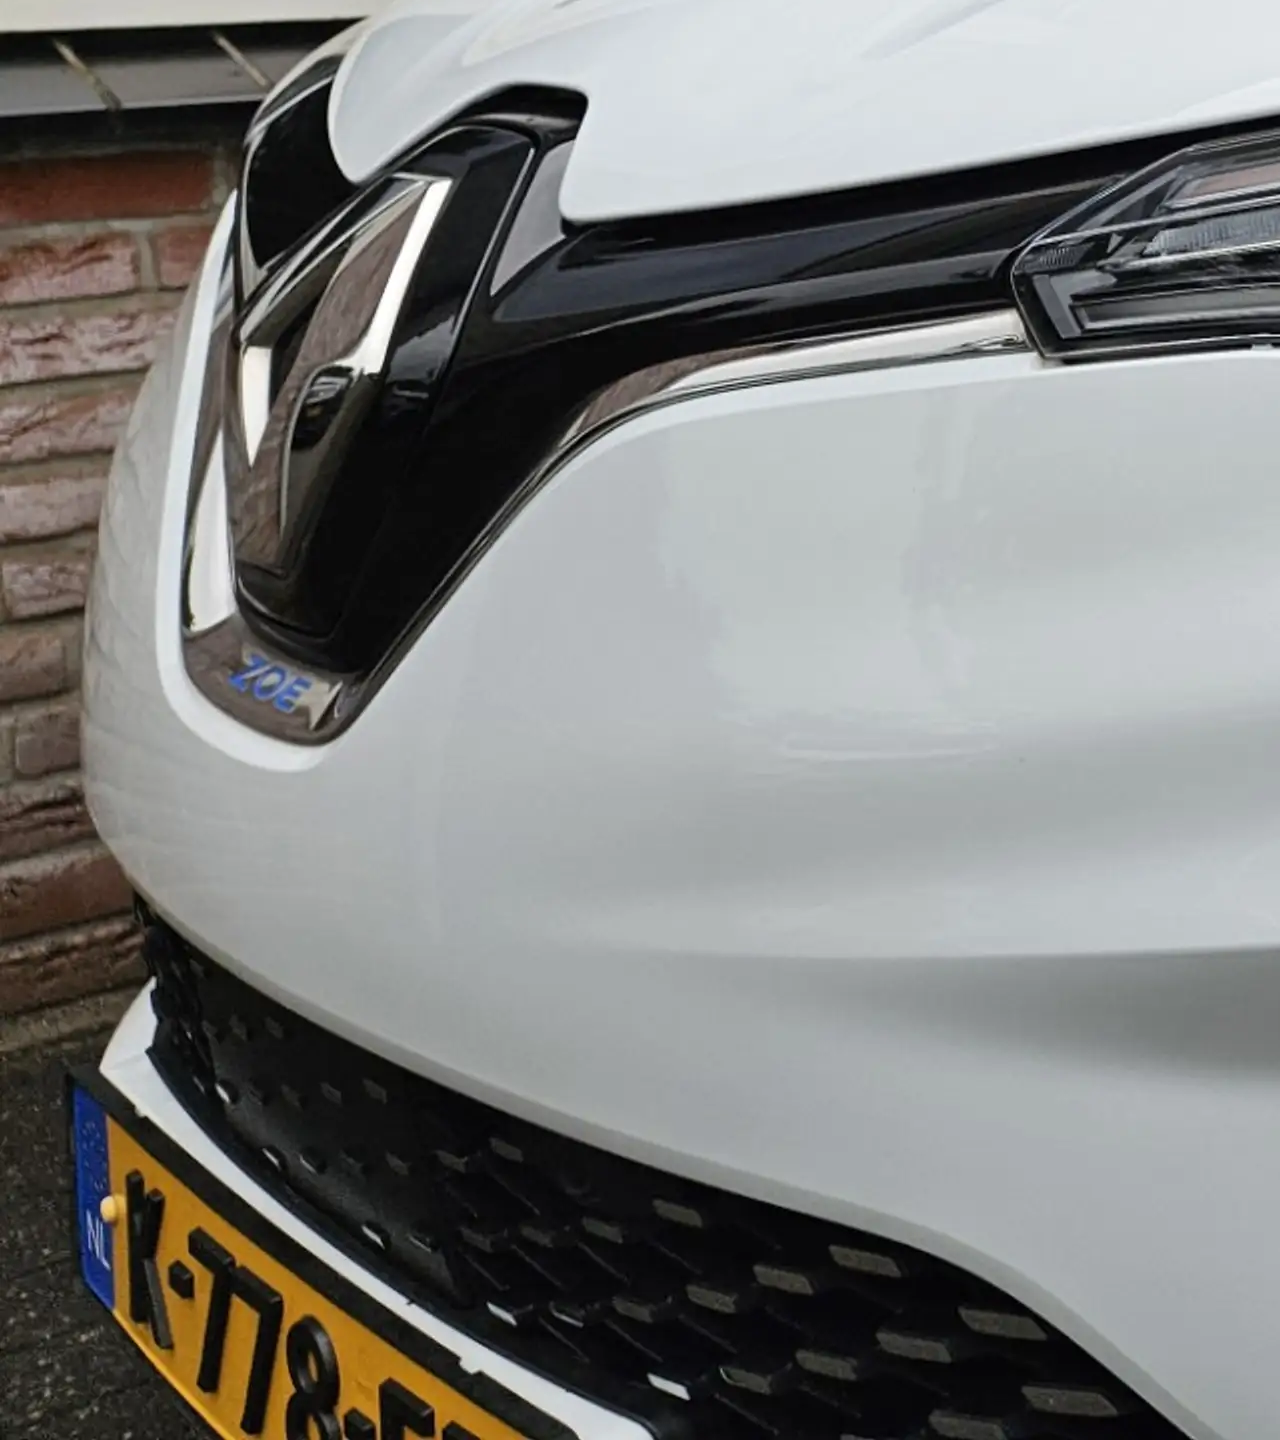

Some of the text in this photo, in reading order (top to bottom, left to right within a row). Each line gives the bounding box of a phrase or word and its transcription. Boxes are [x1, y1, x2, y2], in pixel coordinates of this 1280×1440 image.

[228, 651, 312, 714] ZOE
[86, 1210, 111, 1270] NL
[125, 1168, 482, 1440] K-778-
